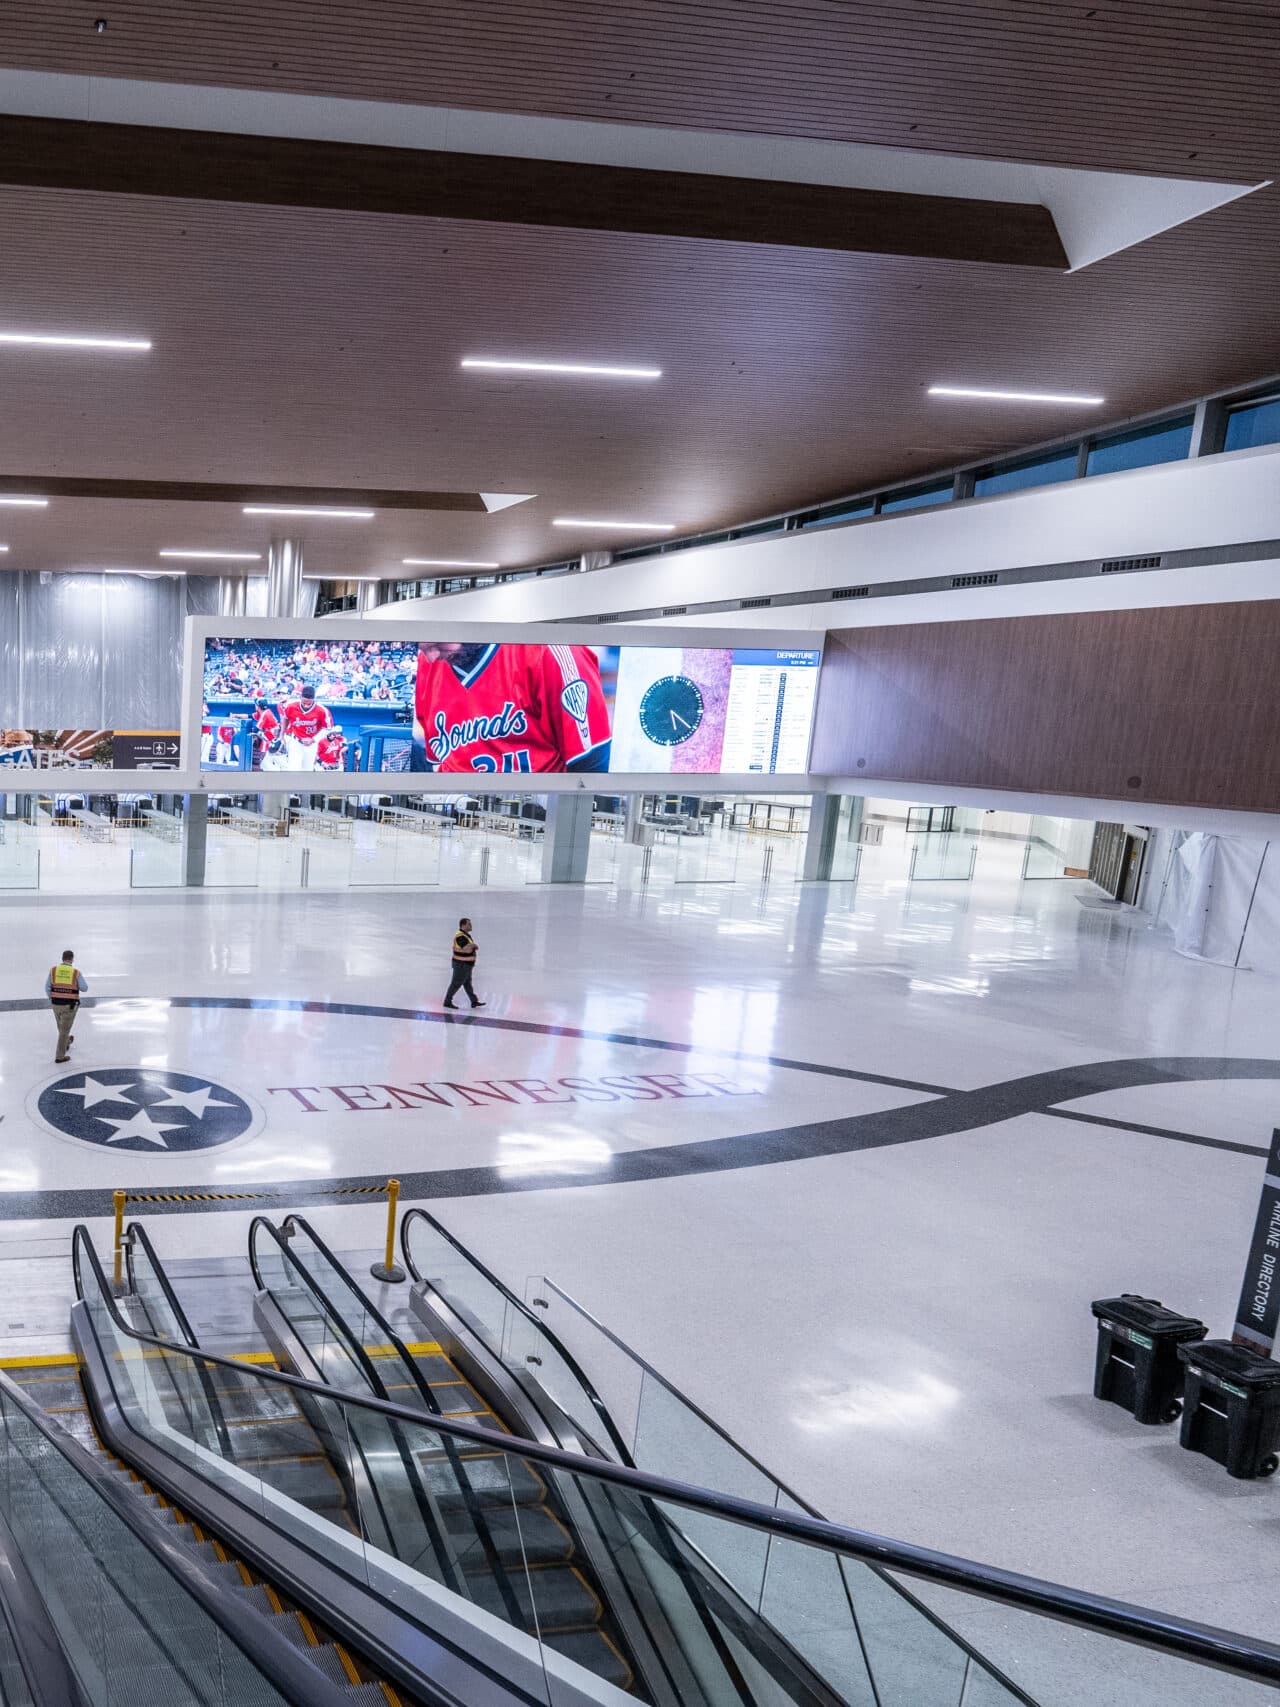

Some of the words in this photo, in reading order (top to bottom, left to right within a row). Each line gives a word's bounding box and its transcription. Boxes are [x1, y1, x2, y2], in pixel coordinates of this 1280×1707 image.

[429, 701, 528, 763] Sounds
[268, 1072, 765, 1113] TENNESSEE
[1251, 1254, 1276, 1322] DIRECTORY
